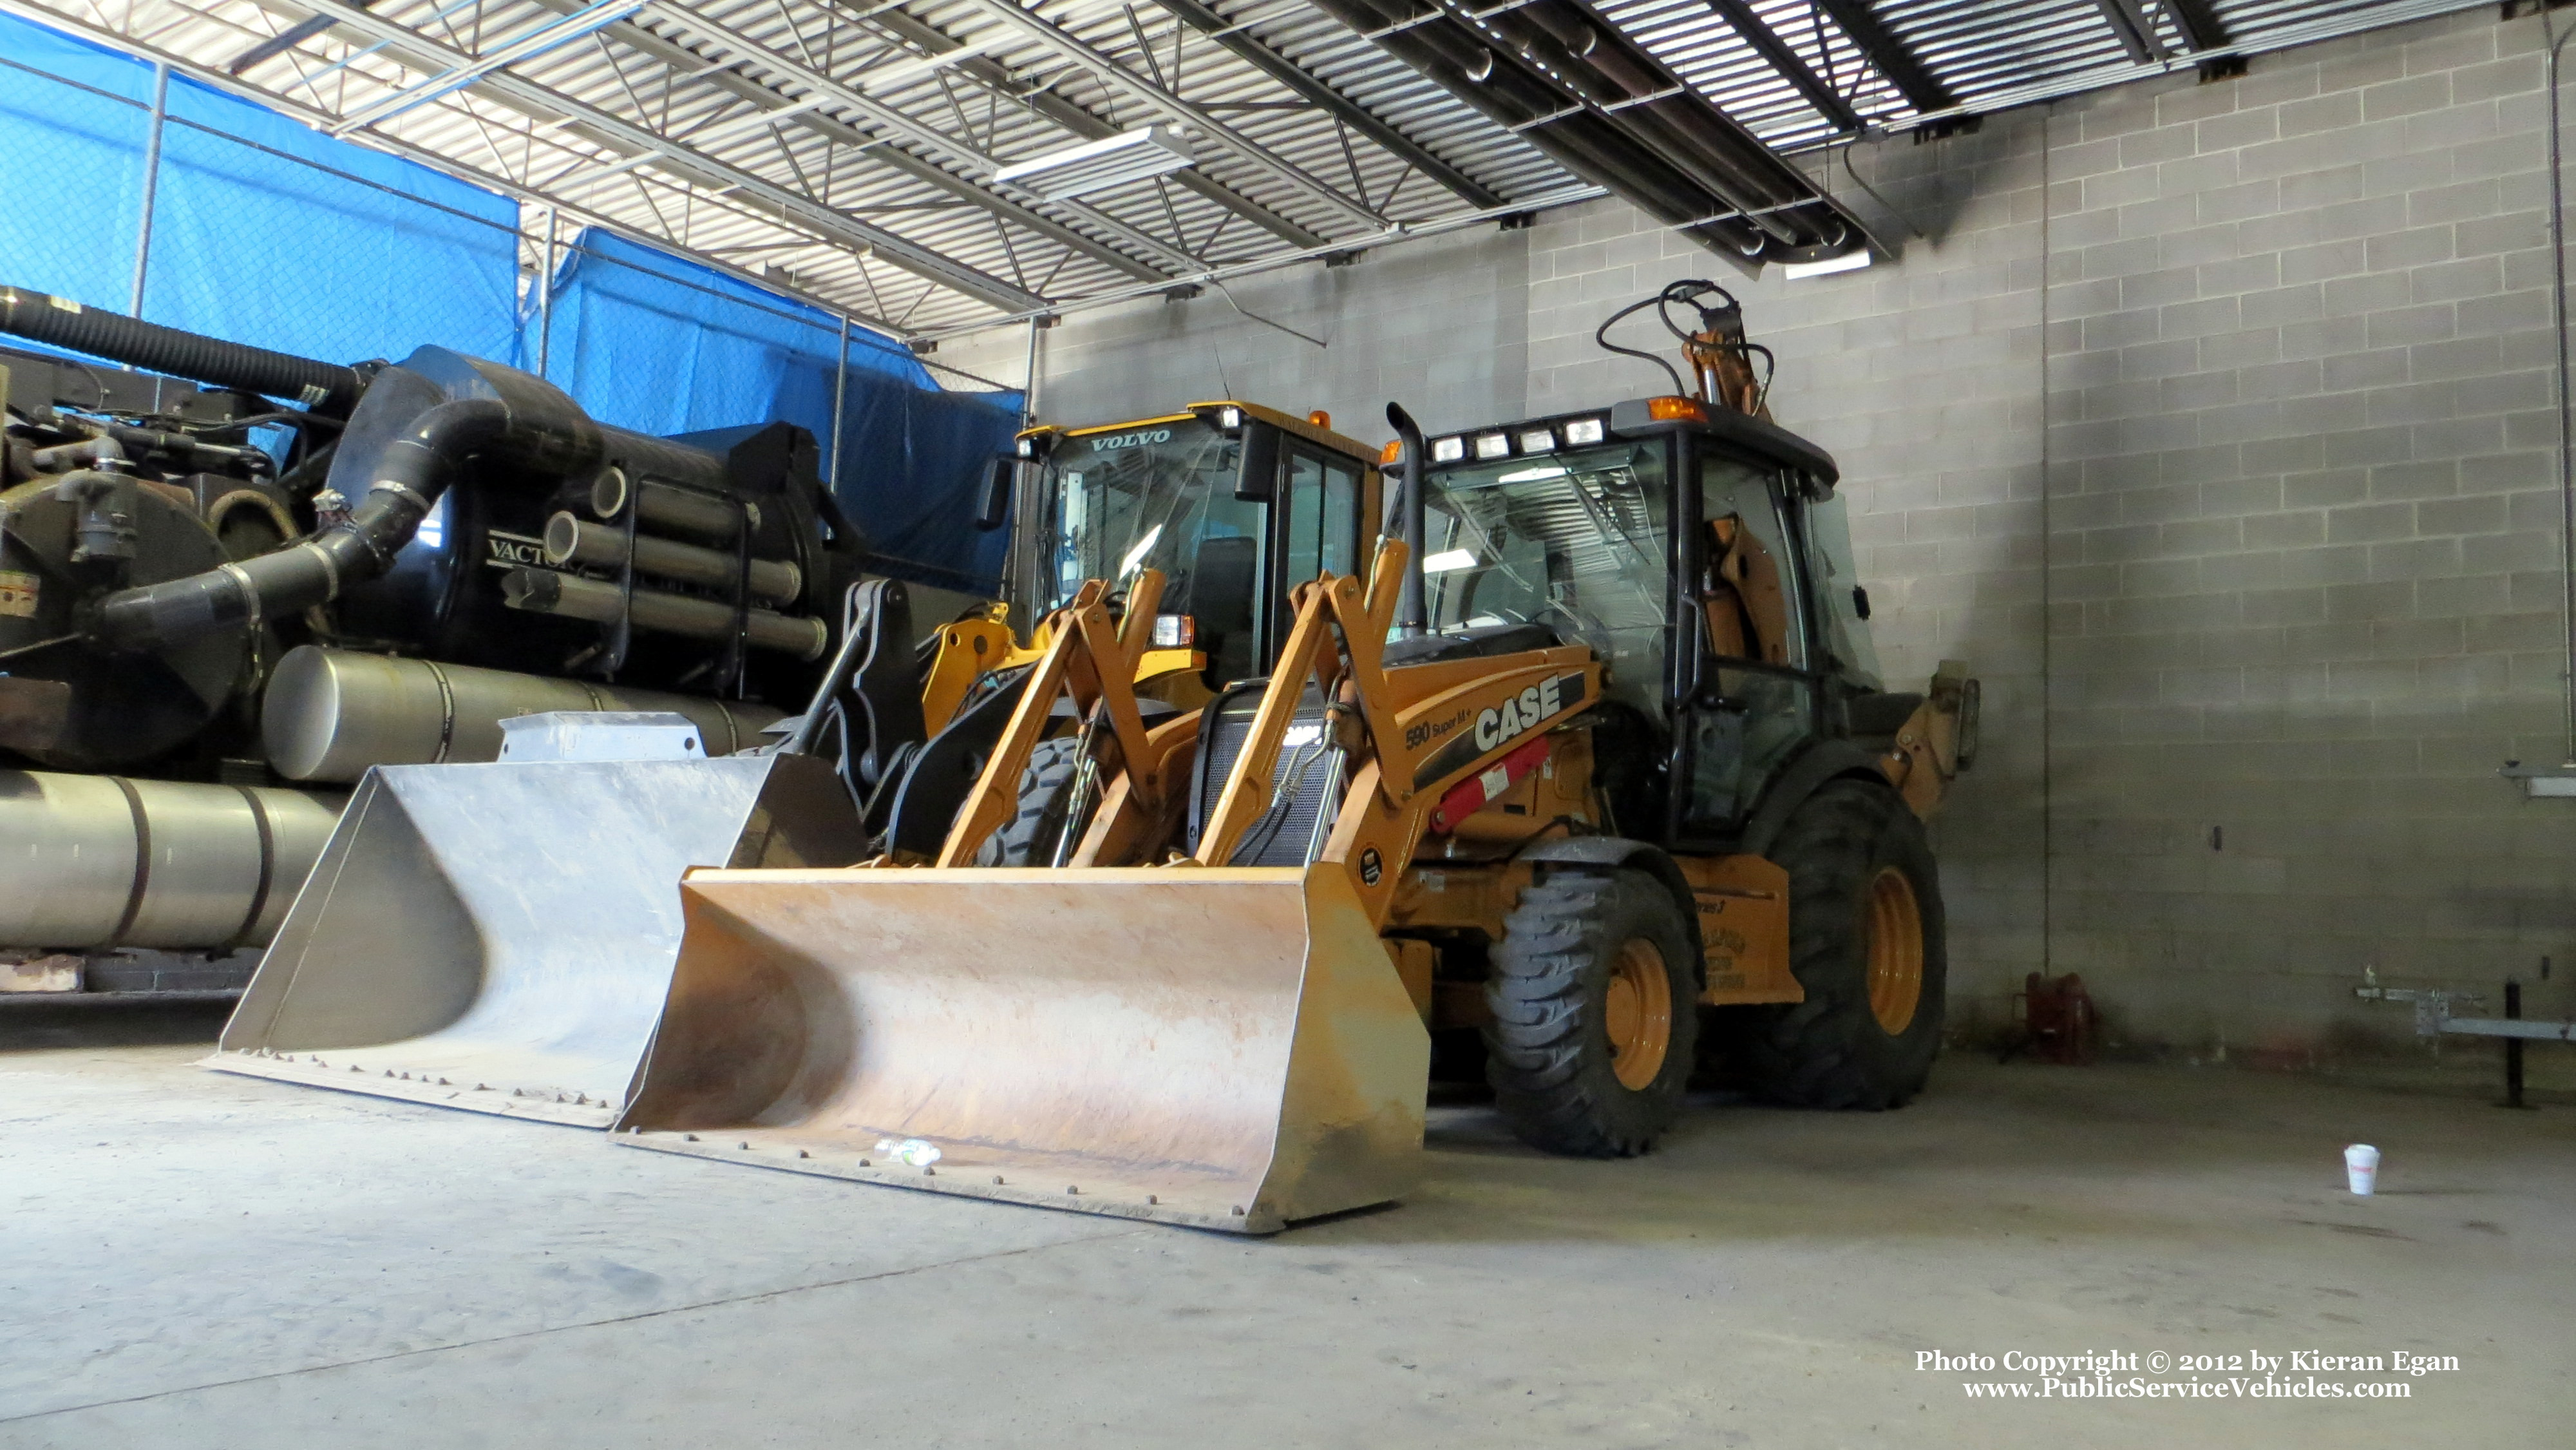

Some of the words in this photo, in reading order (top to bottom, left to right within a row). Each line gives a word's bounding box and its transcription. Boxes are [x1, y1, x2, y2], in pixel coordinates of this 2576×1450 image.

[1091, 428, 1171, 452] VOLVO
[1474, 674, 1561, 752] CASE
[1405, 720, 1431, 750] 590
[1432, 716, 1457, 738] Super
